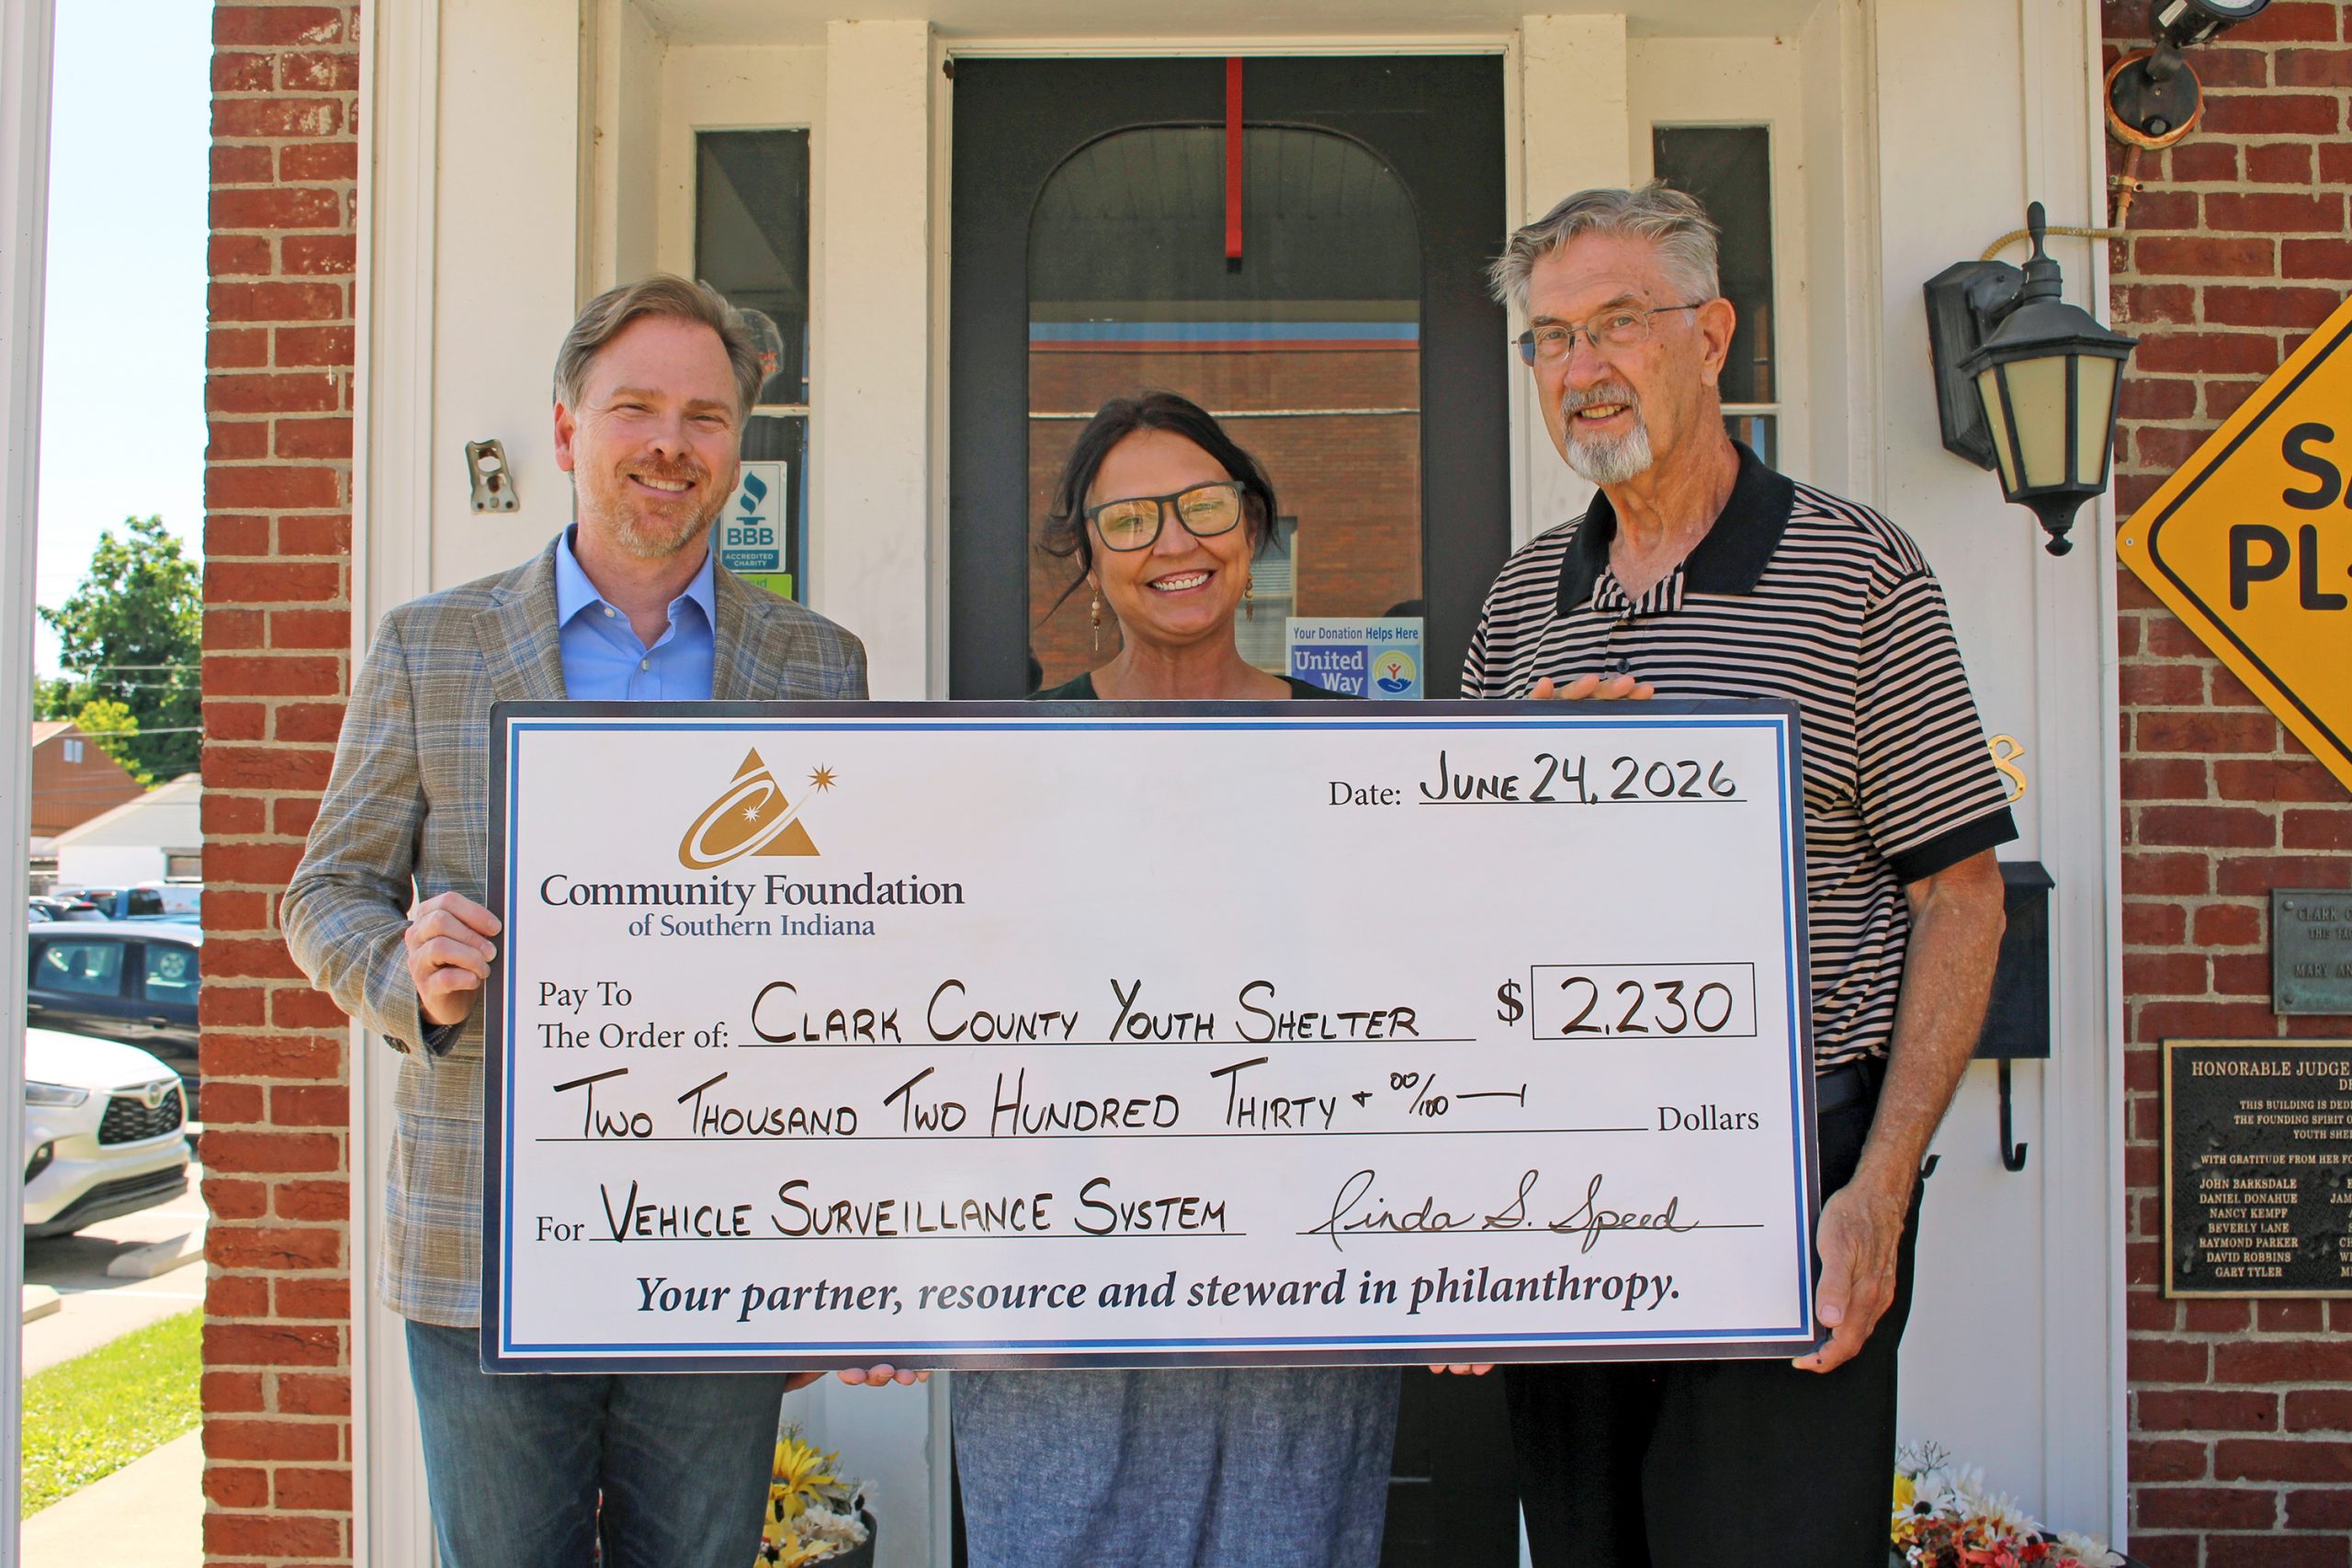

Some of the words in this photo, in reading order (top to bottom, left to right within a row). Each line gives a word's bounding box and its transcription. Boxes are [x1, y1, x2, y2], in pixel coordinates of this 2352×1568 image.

[2282, 423, 2352, 510] S
[728, 528, 774, 545] BBB
[2230, 524, 2352, 611] PL
[1294, 627, 1316, 638] Your
[1319, 626, 1363, 639] Donation
[1366, 626, 1392, 641] Helps
[1396, 626, 1419, 638] Here
[1295, 651, 1363, 670] United
[1321, 672, 1363, 694] Way
[1329, 782, 1401, 806] Date:
[1419, 750, 1520, 800] JUNE
[1611, 756, 1736, 798] 2026
[540, 874, 756, 916] Community
[765, 872, 965, 905] Foundation
[2298, 908, 2336, 920] CLARK
[628, 914, 655, 936] of
[661, 915, 772, 936] Southern
[781, 914, 875, 935] Indiana
[2295, 964, 2328, 977] MARY
[539, 982, 588, 1014] Pay
[597, 981, 632, 1006] To
[538, 1023, 589, 1048] The
[600, 1022, 684, 1048] Order
[694, 1021, 729, 1047] of:
[752, 980, 901, 1043] CLARK
[927, 979, 1078, 1042] COUNTY
[1109, 979, 1214, 1042] YOUTH
[1236, 980, 1419, 1042] SHELTER
[1497, 978, 1523, 1026] $
[2191, 1062, 2290, 1076] HONORABLE
[2297, 1062, 2349, 1076] JUDGE
[553, 1067, 653, 1138] TWO
[678, 1071, 857, 1135] THOUSAND
[883, 1066, 967, 1133] TWO
[990, 1067, 1179, 1136] HUNDRED
[1210, 1056, 1336, 1130] THIRTY
[1657, 1105, 1759, 1132] Dollars
[2240, 1100, 2263, 1110] THIS
[2267, 1100, 2314, 1110] BUILDING
[2317, 1100, 2327, 1110] IS
[2233, 1115, 2254, 1124] THE
[2257, 1115, 2309, 1124] FOUNDING
[2312, 1115, 2344, 1124] SPIRIT
[2293, 1130, 2326, 1139] YOUTH
[2201, 1155, 2227, 1164] WITH
[2230, 1155, 2285, 1164] GRATITUDE
[2289, 1155, 2316, 1164] FROM
[2319, 1155, 2339, 1164] HER
[2199, 1179, 2229, 1189] JOHN
[2233, 1179, 2297, 1189] BARKSDALE
[2199, 1194, 2241, 1203] DANIEL
[2245, 1194, 2297, 1203] DONAHUE
[537, 1216, 585, 1241] For
[601, 1179, 752, 1243] VEHICLE
[772, 1179, 1052, 1237] SURVEILLANCE
[1075, 1177, 1227, 1235] SYSTEM
[2210, 1209, 2247, 1218] NANCY
[2251, 1209, 2288, 1218] KEMPF
[2209, 1224, 2257, 1233] BEVERLY
[2261, 1224, 2290, 1233] LANE
[2199, 1238, 2252, 1247] RAYMOND
[2256, 1238, 2298, 1247] PARKER
[2207, 1253, 2240, 1262] DAVID
[2244, 1253, 2291, 1262] ROBBINS
[2215, 1268, 2245, 1277] GARY
[2247, 1268, 2282, 1277] TYLER
[637, 1276, 730, 1312] Your
[738, 1278, 902, 1324] partner,
[919, 1281, 1086, 1311] resource
[1098, 1271, 1176, 1310] and
[1187, 1269, 1347, 1306] steward
[1359, 1270, 1397, 1304] in
[1407, 1265, 1680, 1315] philanthropy.
